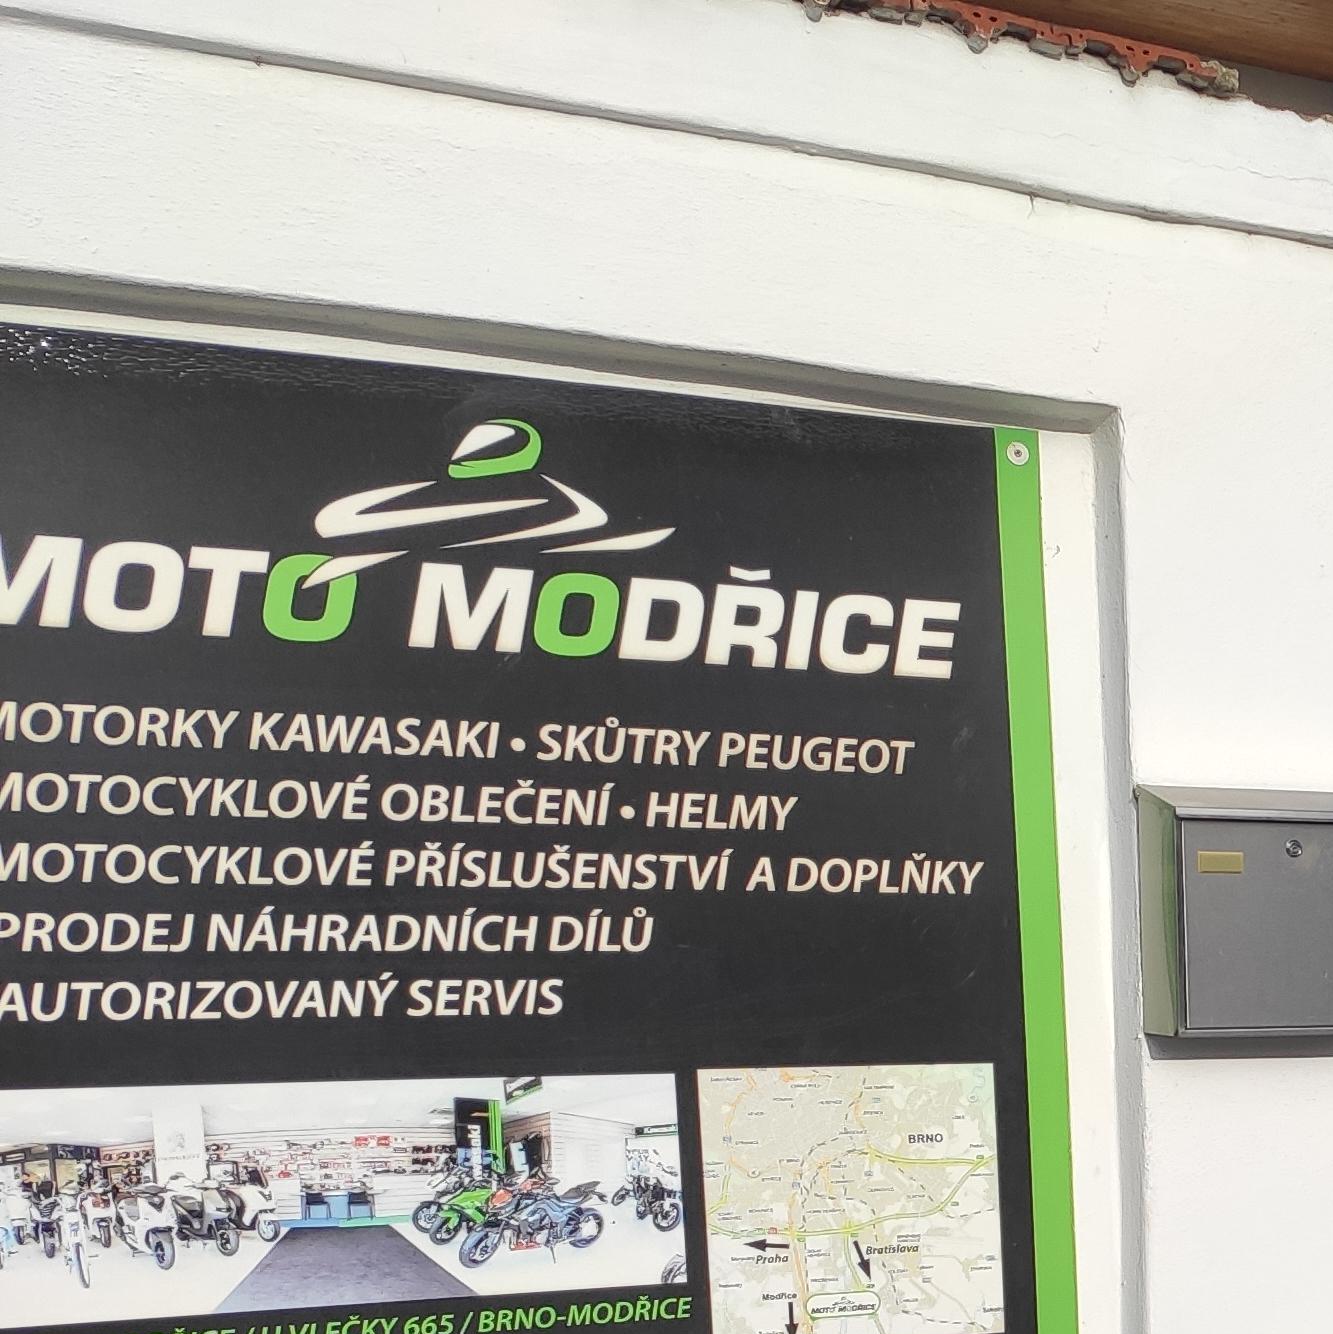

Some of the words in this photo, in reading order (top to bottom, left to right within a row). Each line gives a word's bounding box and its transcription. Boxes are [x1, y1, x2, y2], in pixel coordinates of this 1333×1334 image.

[0, 533, 359, 643] MOTO
[408, 562, 962, 680] MODŘICE
[248, 710, 501, 760] KAWASAKI
[536, 717, 711, 769] SKŮTRY
[718, 732, 916, 776] PEUGEOT
[380, 781, 616, 827] OBLEČENÍ
[646, 791, 799, 832] HELMY
[385, 846, 730, 893] PŘÍSLUŠENSTVÍ
[746, 857, 776, 892] A
[787, 853, 984, 897] DOPLŇKY
[206, 907, 539, 954] NÁHRADNÍCH
[549, 904, 654, 953] DÍLŮ
[0, 970, 397, 1022] AUTORIZOVANÝ
[406, 978, 565, 1018] SERVIS
[907, 1132, 944, 1145] BRNO
[865, 1243, 919, 1256] Bratislava
[477, 1295, 693, 1334] BRNO-MODŘICE
